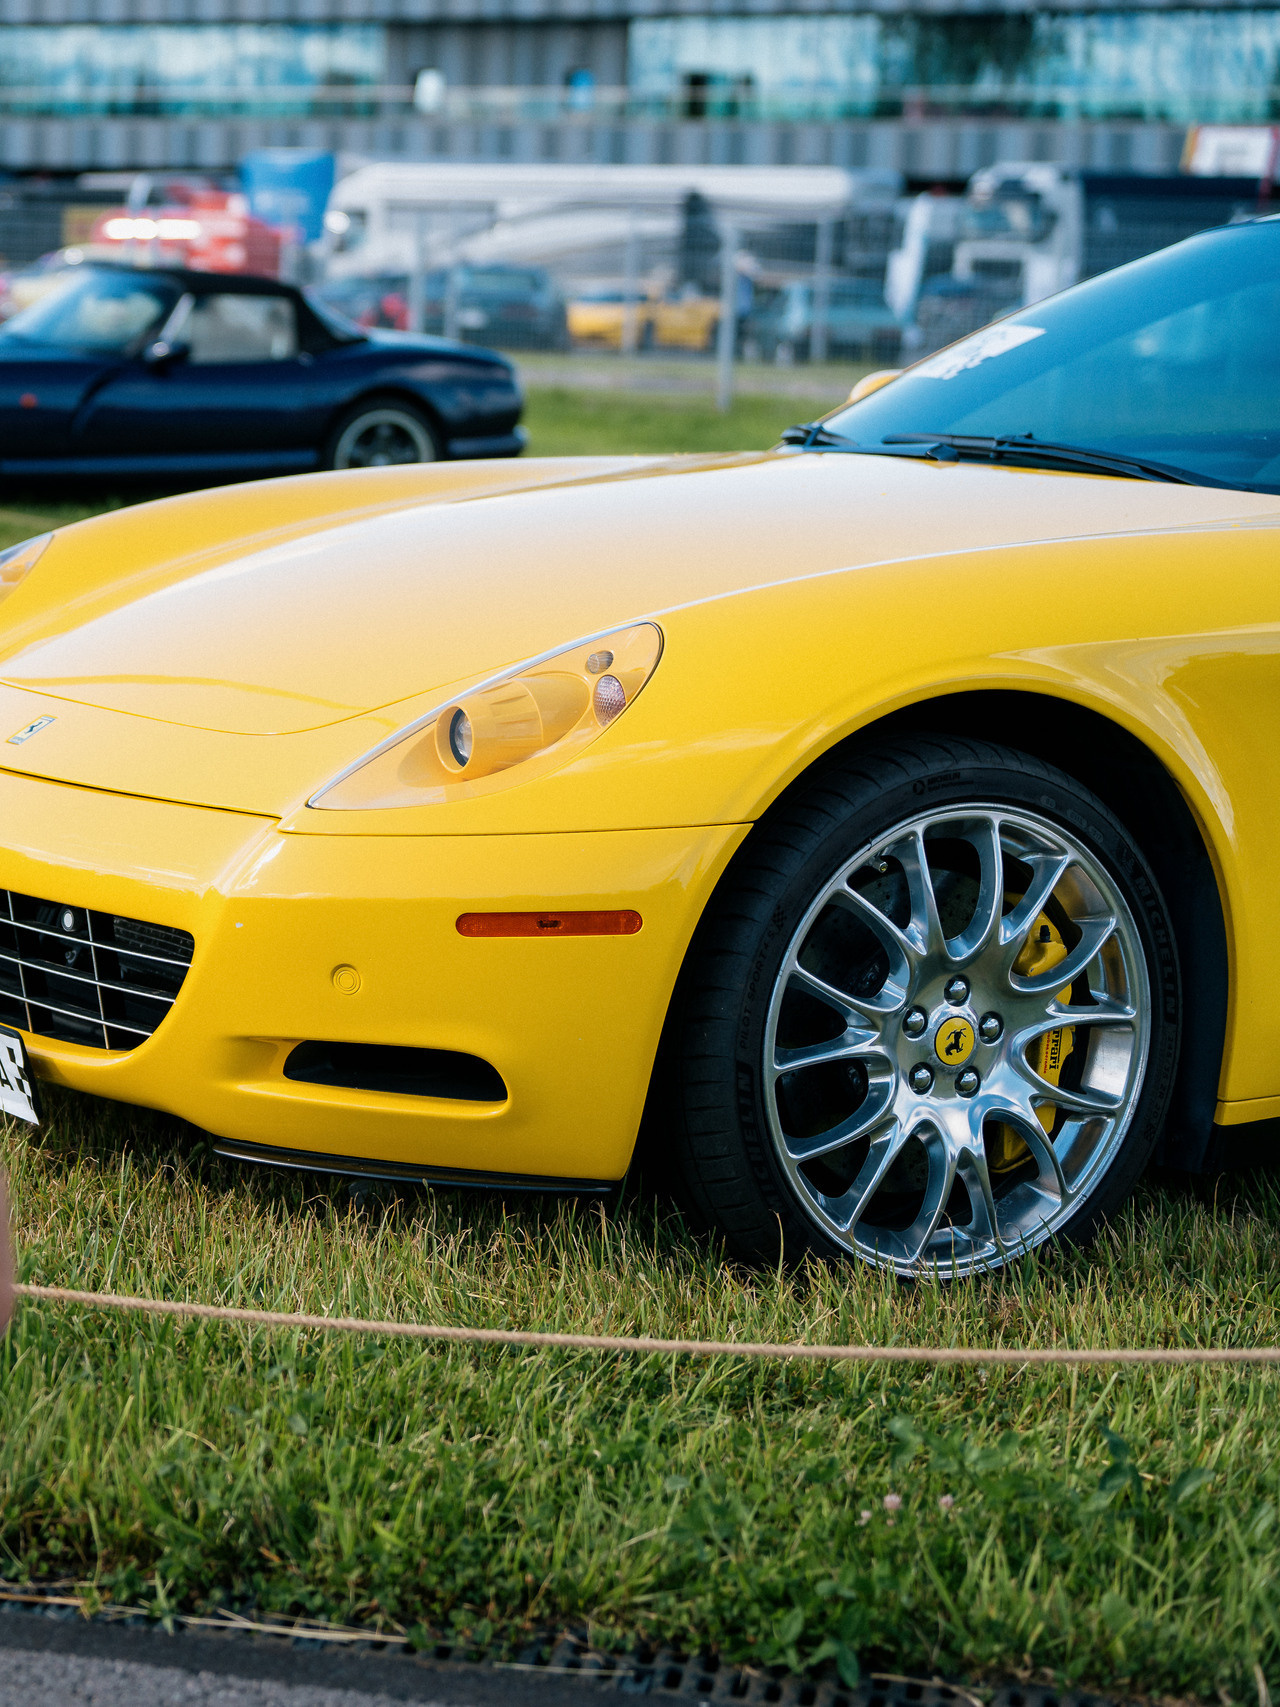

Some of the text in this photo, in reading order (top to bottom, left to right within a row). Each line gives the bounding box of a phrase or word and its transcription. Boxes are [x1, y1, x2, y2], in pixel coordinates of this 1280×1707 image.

[739, 1005, 752, 1050] PILOT
[747, 949, 768, 1002] SPORT
[1135, 876, 1176, 1015] MICHELIN
